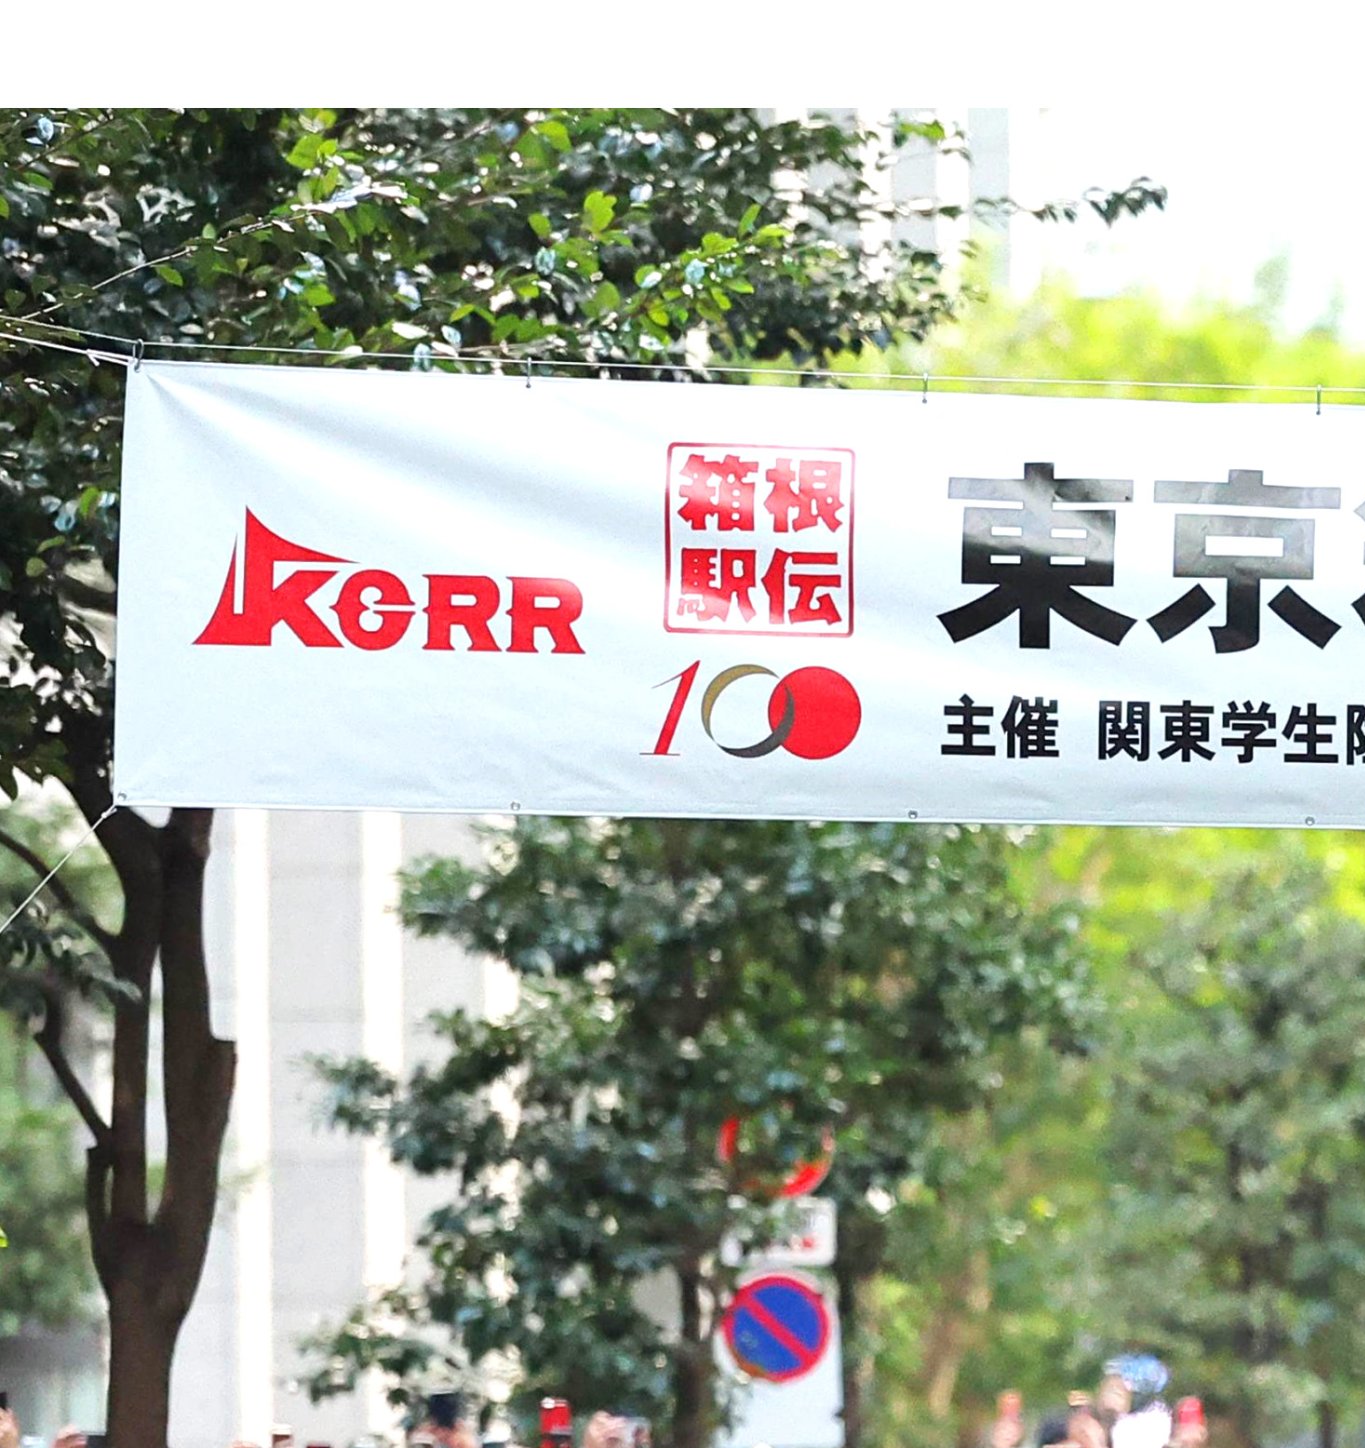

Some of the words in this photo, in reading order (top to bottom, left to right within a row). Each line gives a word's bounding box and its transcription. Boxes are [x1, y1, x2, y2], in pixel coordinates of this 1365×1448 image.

[677, 453, 845, 534] 箱根
[676, 547, 843, 627] 駅伝
[940, 694, 1059, 760] 主催
